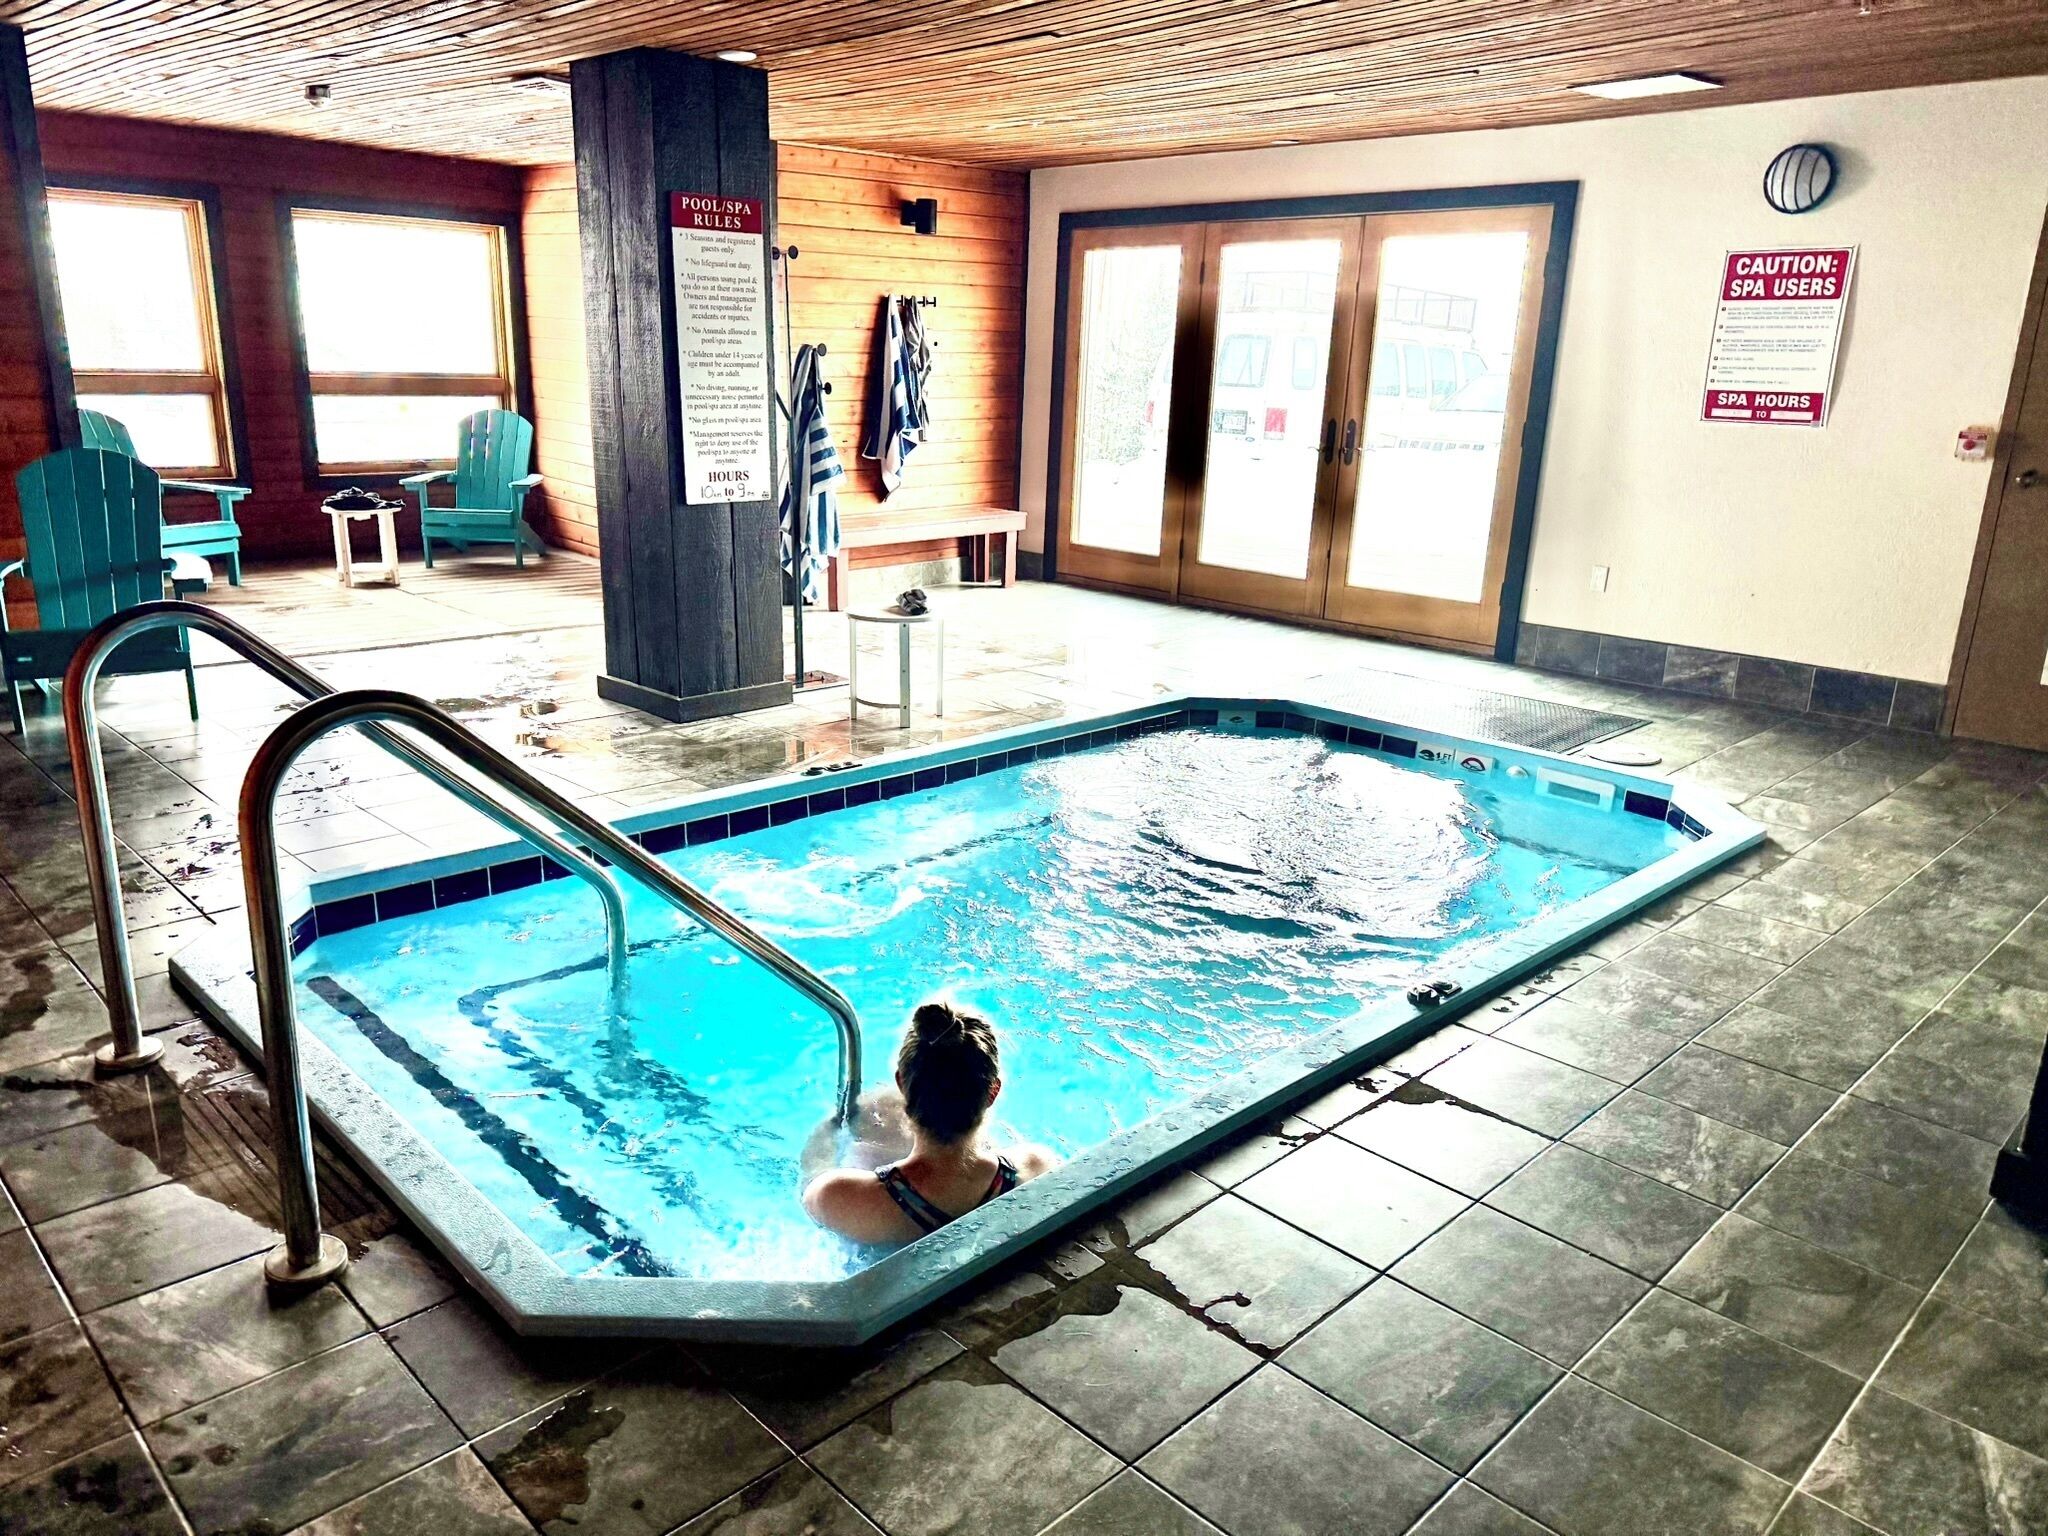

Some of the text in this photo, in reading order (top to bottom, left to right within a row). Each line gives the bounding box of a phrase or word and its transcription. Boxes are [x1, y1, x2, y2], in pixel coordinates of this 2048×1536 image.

[682, 197, 752, 215] POOL/SPA
[694, 213, 742, 229] RULES
[690, 233, 713, 242] Seasons
[727, 238, 756, 246] registered
[702, 259, 728, 268] lifeguard
[1736, 255, 1839, 275] CAUTION:
[720, 276, 736, 284] using
[738, 277, 750, 285] pool
[1730, 277, 1837, 297] SPA USERS
[728, 328, 750, 336] allowed
[688, 350, 713, 358] Children
[1718, 393, 1811, 408] SPA HOURS
[695, 440, 708, 448] right
[709, 471, 749, 482] HOURS
[725, 488, 734, 496] to
